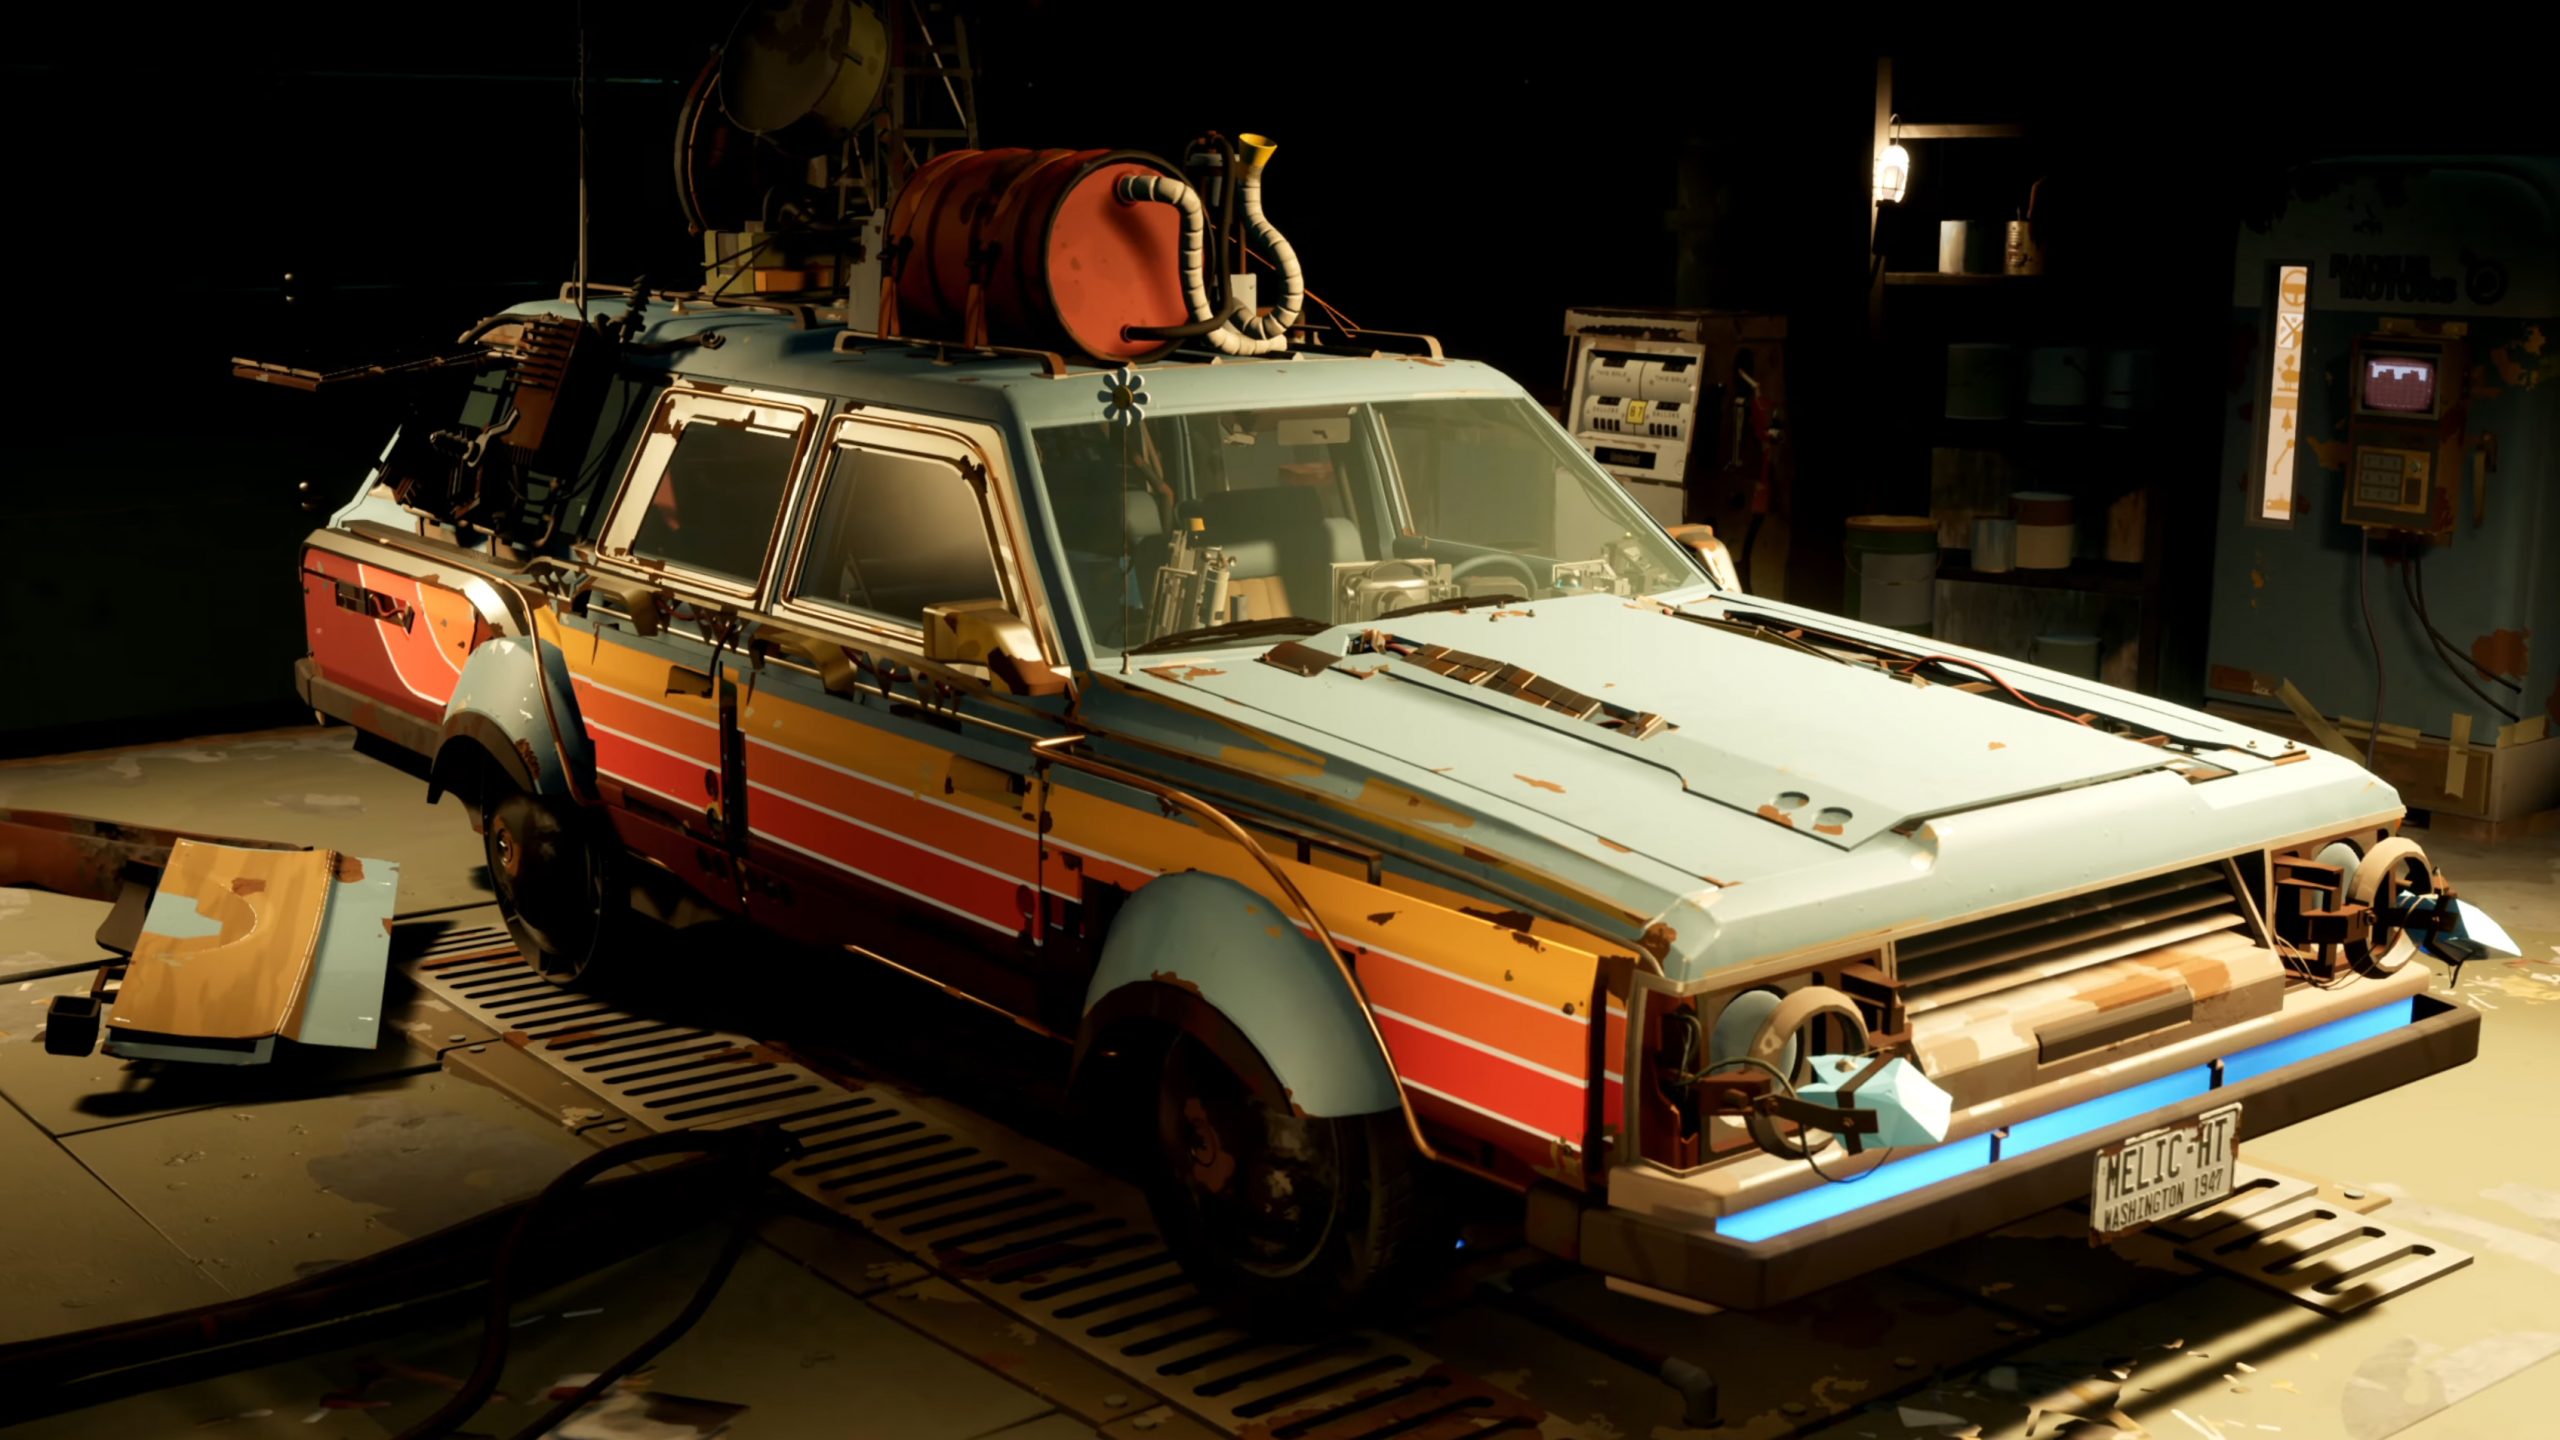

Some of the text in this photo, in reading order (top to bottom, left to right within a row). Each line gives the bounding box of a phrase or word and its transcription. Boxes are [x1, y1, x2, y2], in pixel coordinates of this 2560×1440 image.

[2105, 1117, 2228, 1202] MELIC-HT
[2104, 1168, 2224, 1233] WASHINGTON 1947
